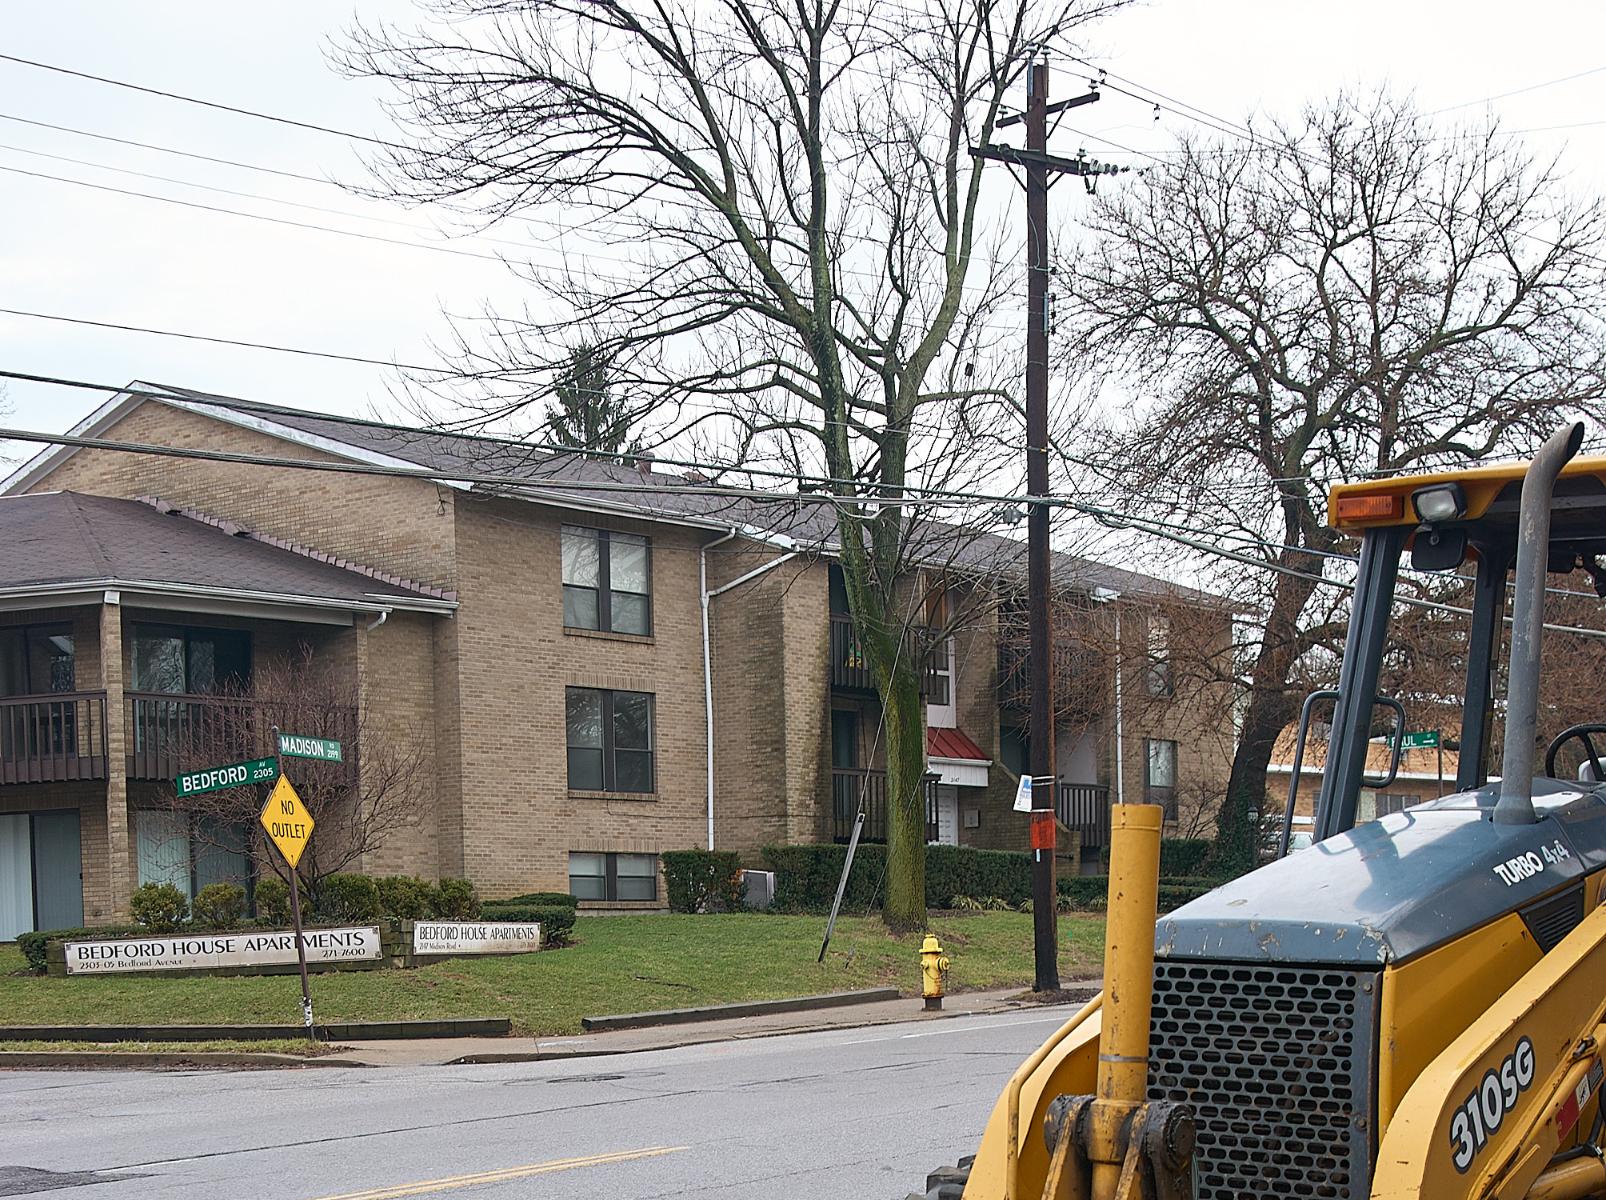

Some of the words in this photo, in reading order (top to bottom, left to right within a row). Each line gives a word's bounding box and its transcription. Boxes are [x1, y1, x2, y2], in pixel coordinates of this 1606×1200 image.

[281, 736, 324, 757] MADISON
[1391, 735, 1417, 747] PUL
[182, 766, 248, 792] BEDFORD
[253, 767, 274, 779] 2305
[280, 800, 294, 815] NO
[272, 822, 305, 839] OUTLET
[1493, 851, 1544, 886] TURBO
[1540, 839, 1570, 864] 4x4
[419, 926, 458, 940] BEDFORD
[461, 926, 487, 940] HOUSE
[490, 927, 534, 940] APARTMENTS
[78, 943, 165, 960] BEDFORD
[173, 939, 236, 955] HOUSE
[1452, 1040, 1534, 1169] 310SG
